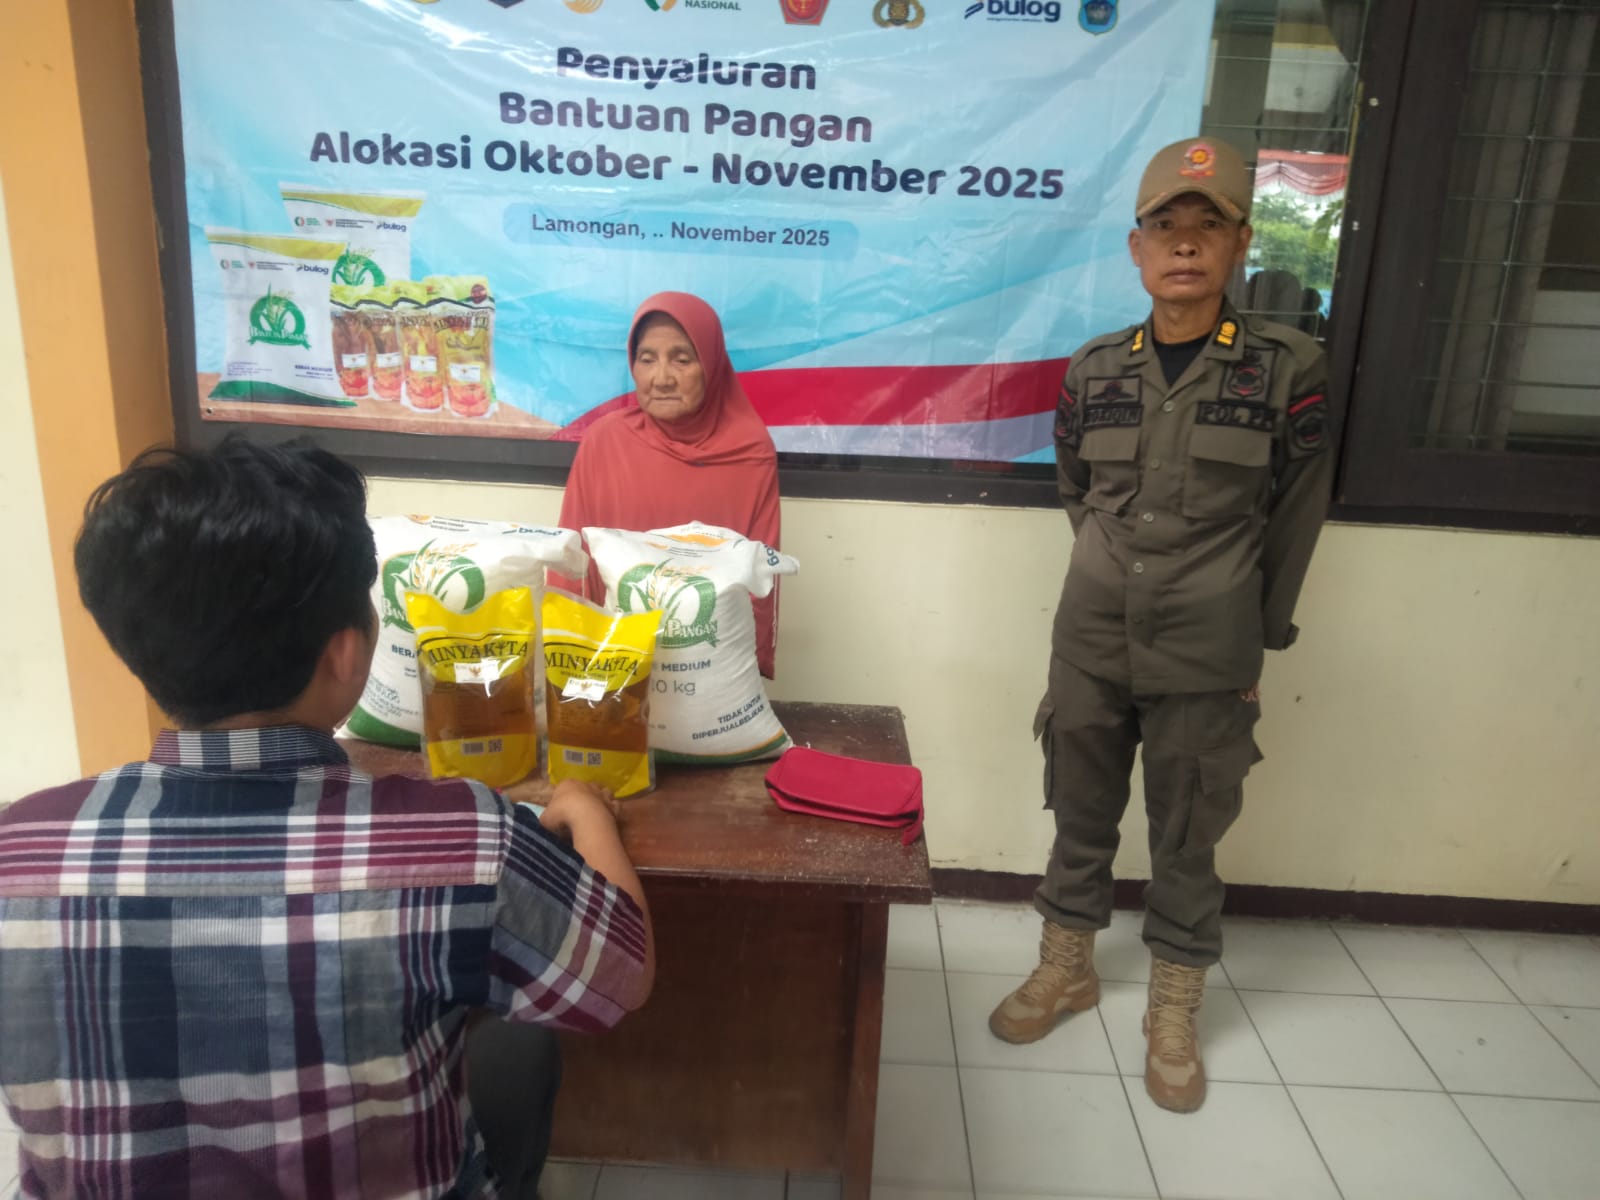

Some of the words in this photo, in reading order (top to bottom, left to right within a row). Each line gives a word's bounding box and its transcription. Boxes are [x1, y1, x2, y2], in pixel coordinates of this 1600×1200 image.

[685, 0, 742, 11] NASIONAL
[987, 0, 1061, 22] bulog
[557, 47, 816, 90] Penyaluran
[500, 92, 689, 133] Bantuan
[704, 103, 872, 148] Pangan
[309, 131, 471, 170] Alokasi
[484, 140, 672, 180] Oktober
[682, 165, 699, 174] -
[711, 153, 947, 195] November
[956, 165, 1064, 199] 2025
[383, 222, 407, 232] bulog
[532, 213, 646, 240] Lamongan,
[671, 222, 776, 243] November
[781, 228, 830, 247] 2025
[303, 264, 329, 275] bulog
[665, 618, 718, 638] PANGAN
[661, 660, 711, 672] MEDIUM
[673, 680, 696, 696] kg
[718, 707, 743, 724] TIDAK
[743, 694, 761, 713] UNTUK
[691, 704, 765, 740] DIPERJUALBELIKAN
